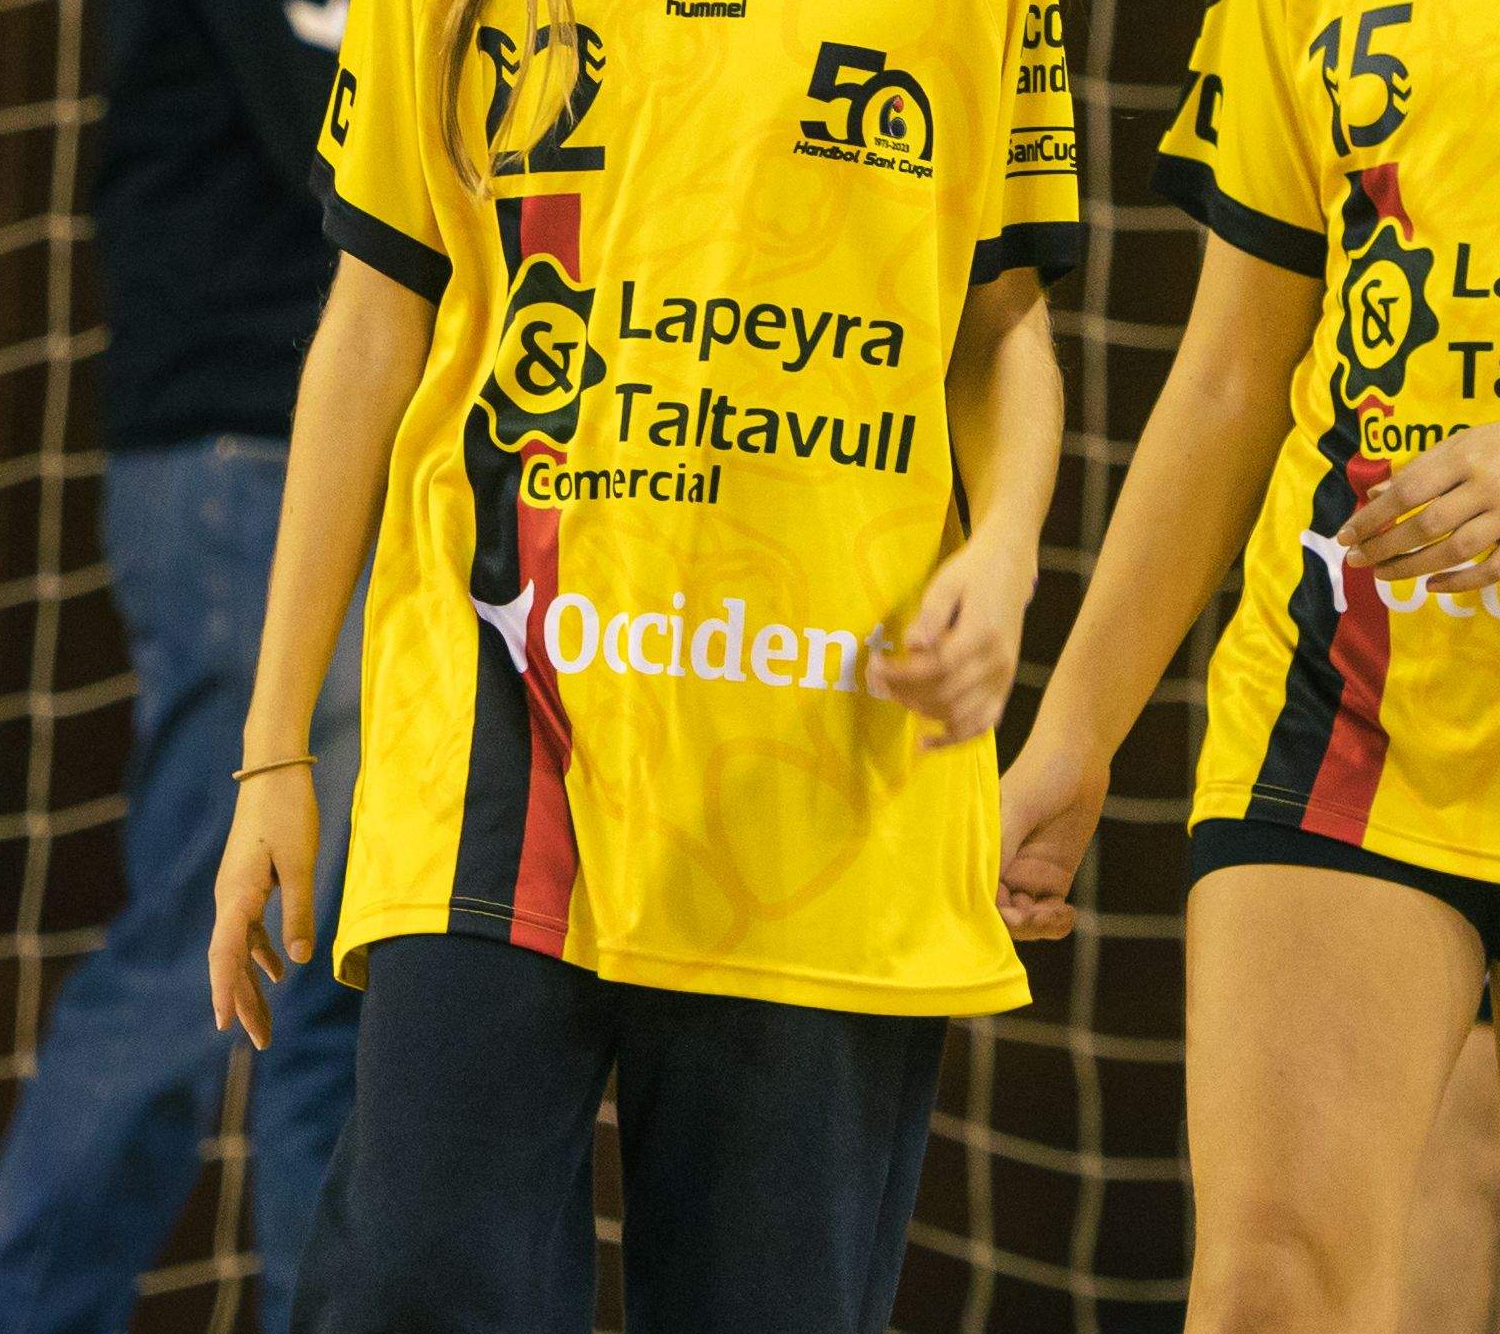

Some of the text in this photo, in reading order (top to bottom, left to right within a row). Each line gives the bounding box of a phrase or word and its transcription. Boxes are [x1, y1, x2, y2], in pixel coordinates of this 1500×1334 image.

[800, 41, 934, 162] 50
[1309, 2, 1413, 157] 15
[793, 141, 933, 179] Handbol Sant Cuga
[619, 281, 905, 373] Lapeyra
[616, 383, 917, 475] Taltavull
[528, 462, 721, 505] Comercial
